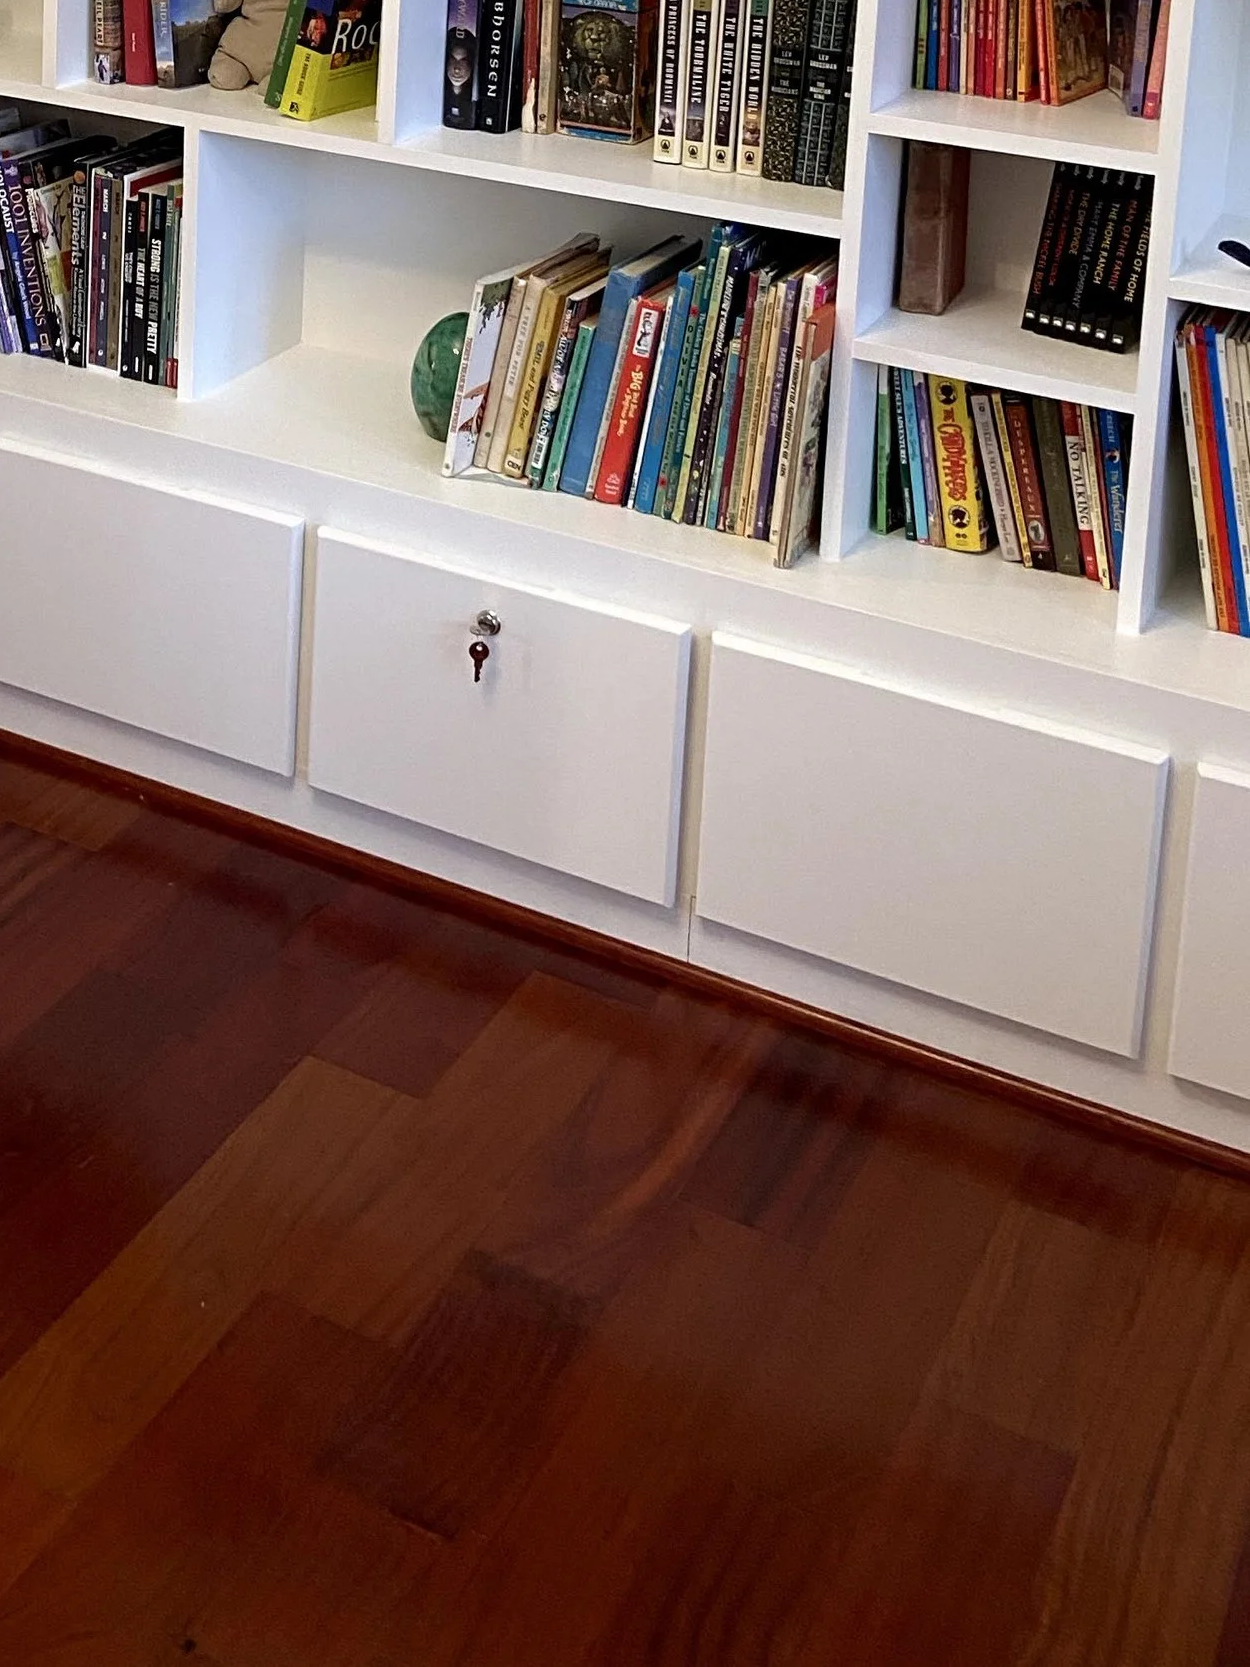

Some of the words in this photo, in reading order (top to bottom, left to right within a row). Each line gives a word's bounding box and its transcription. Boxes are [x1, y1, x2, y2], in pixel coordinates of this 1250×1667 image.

[8, 184, 25, 225] 1001
[17, 230, 45, 326] INVENTIONS
[150, 238, 162, 273] STRONG
[149, 284, 159, 300] THE
[1124, 273, 1139, 302] HOME
[147, 321, 157, 354] PRETTY
[1067, 442, 1081, 461] NO
[1071, 466, 1089, 525] TALKING
